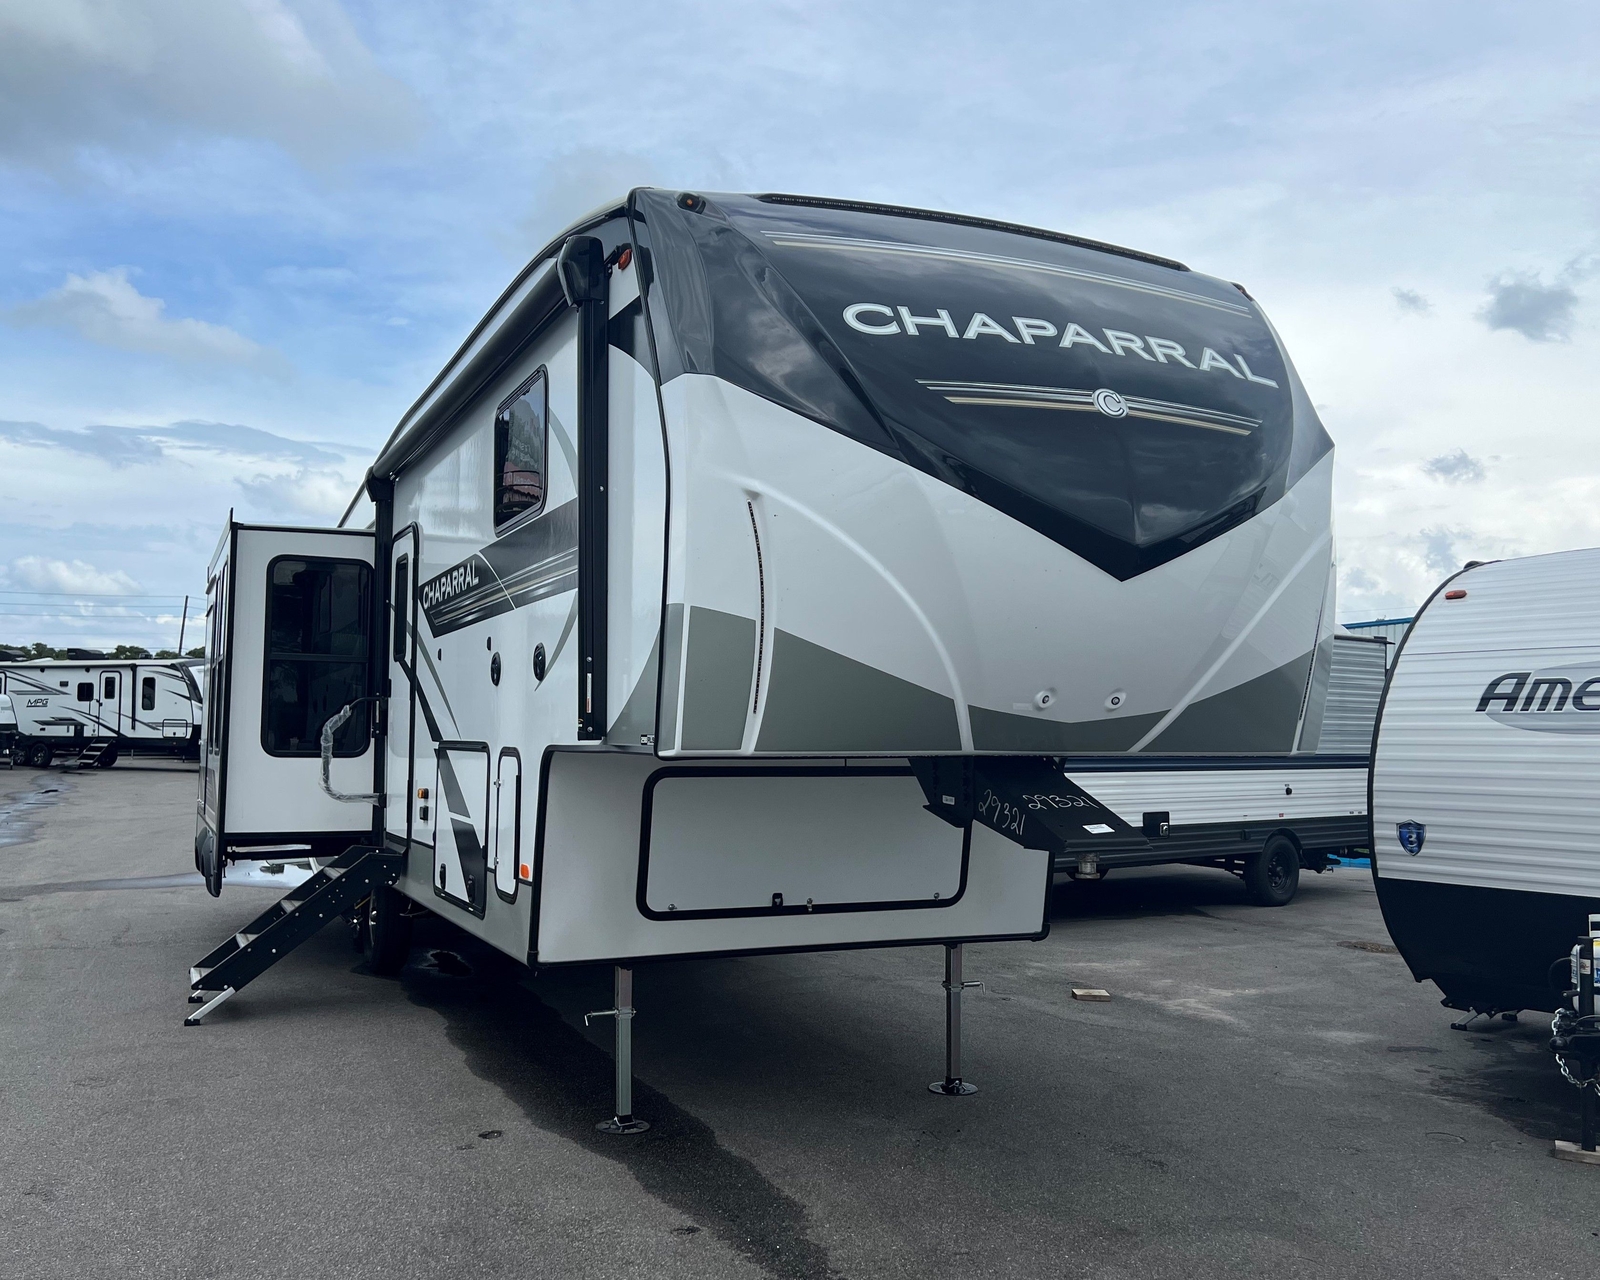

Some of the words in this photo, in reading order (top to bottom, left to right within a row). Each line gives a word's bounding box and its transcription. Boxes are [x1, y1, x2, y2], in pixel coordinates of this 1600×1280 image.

[842, 303, 1279, 388] CHAPARRAL
[422, 560, 479, 609] CHAPARRAL
[26, 698, 49, 707] MPG
[978, 788, 1027, 836] 29321
[1022, 794, 1100, 811] 29321
